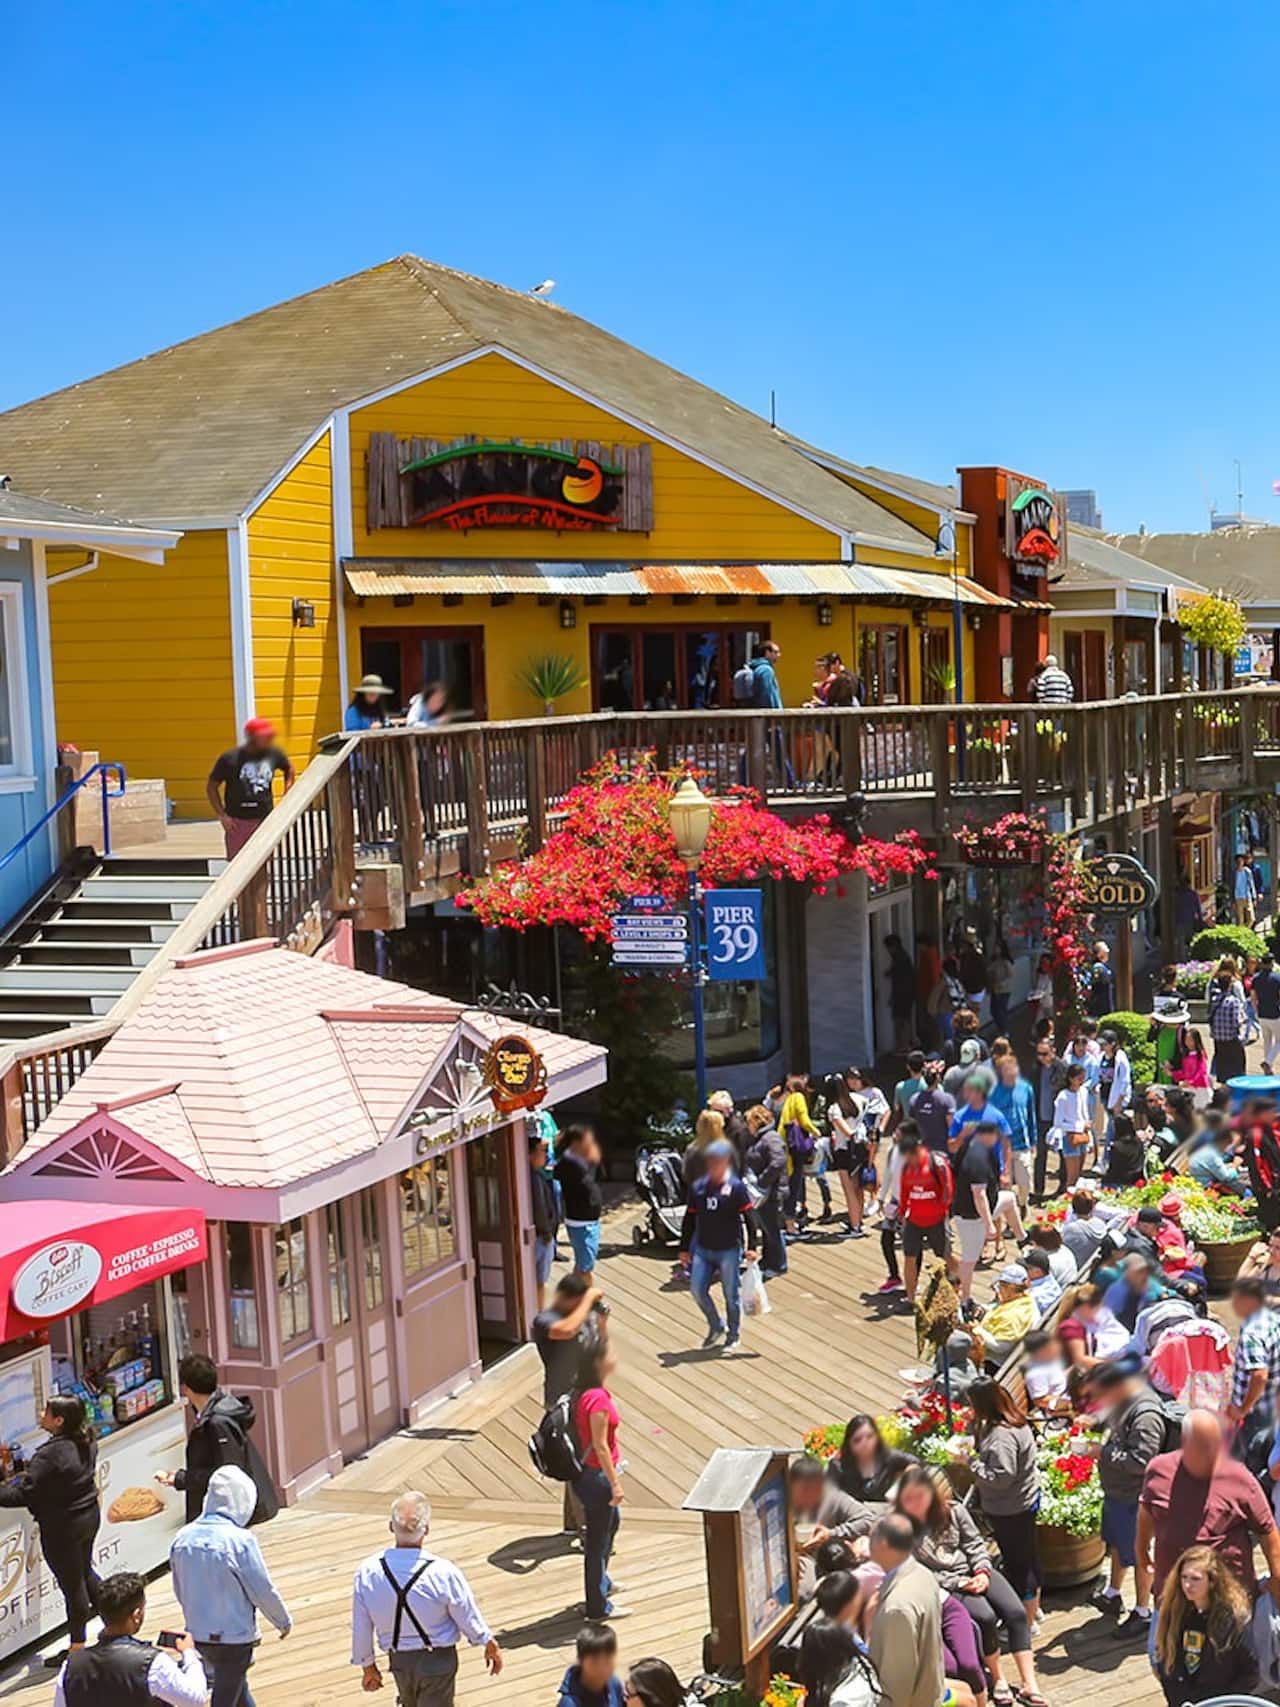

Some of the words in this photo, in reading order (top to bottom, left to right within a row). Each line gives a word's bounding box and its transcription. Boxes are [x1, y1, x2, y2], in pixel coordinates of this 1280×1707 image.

[712, 906, 755, 924] PIER
[712, 924, 759, 964] 39
[111, 1244, 149, 1268] COFFEE
[152, 1227, 195, 1251] ESPRESSO
[107, 1264, 132, 1281] ICED
[133, 1252, 169, 1272] COFFEE
